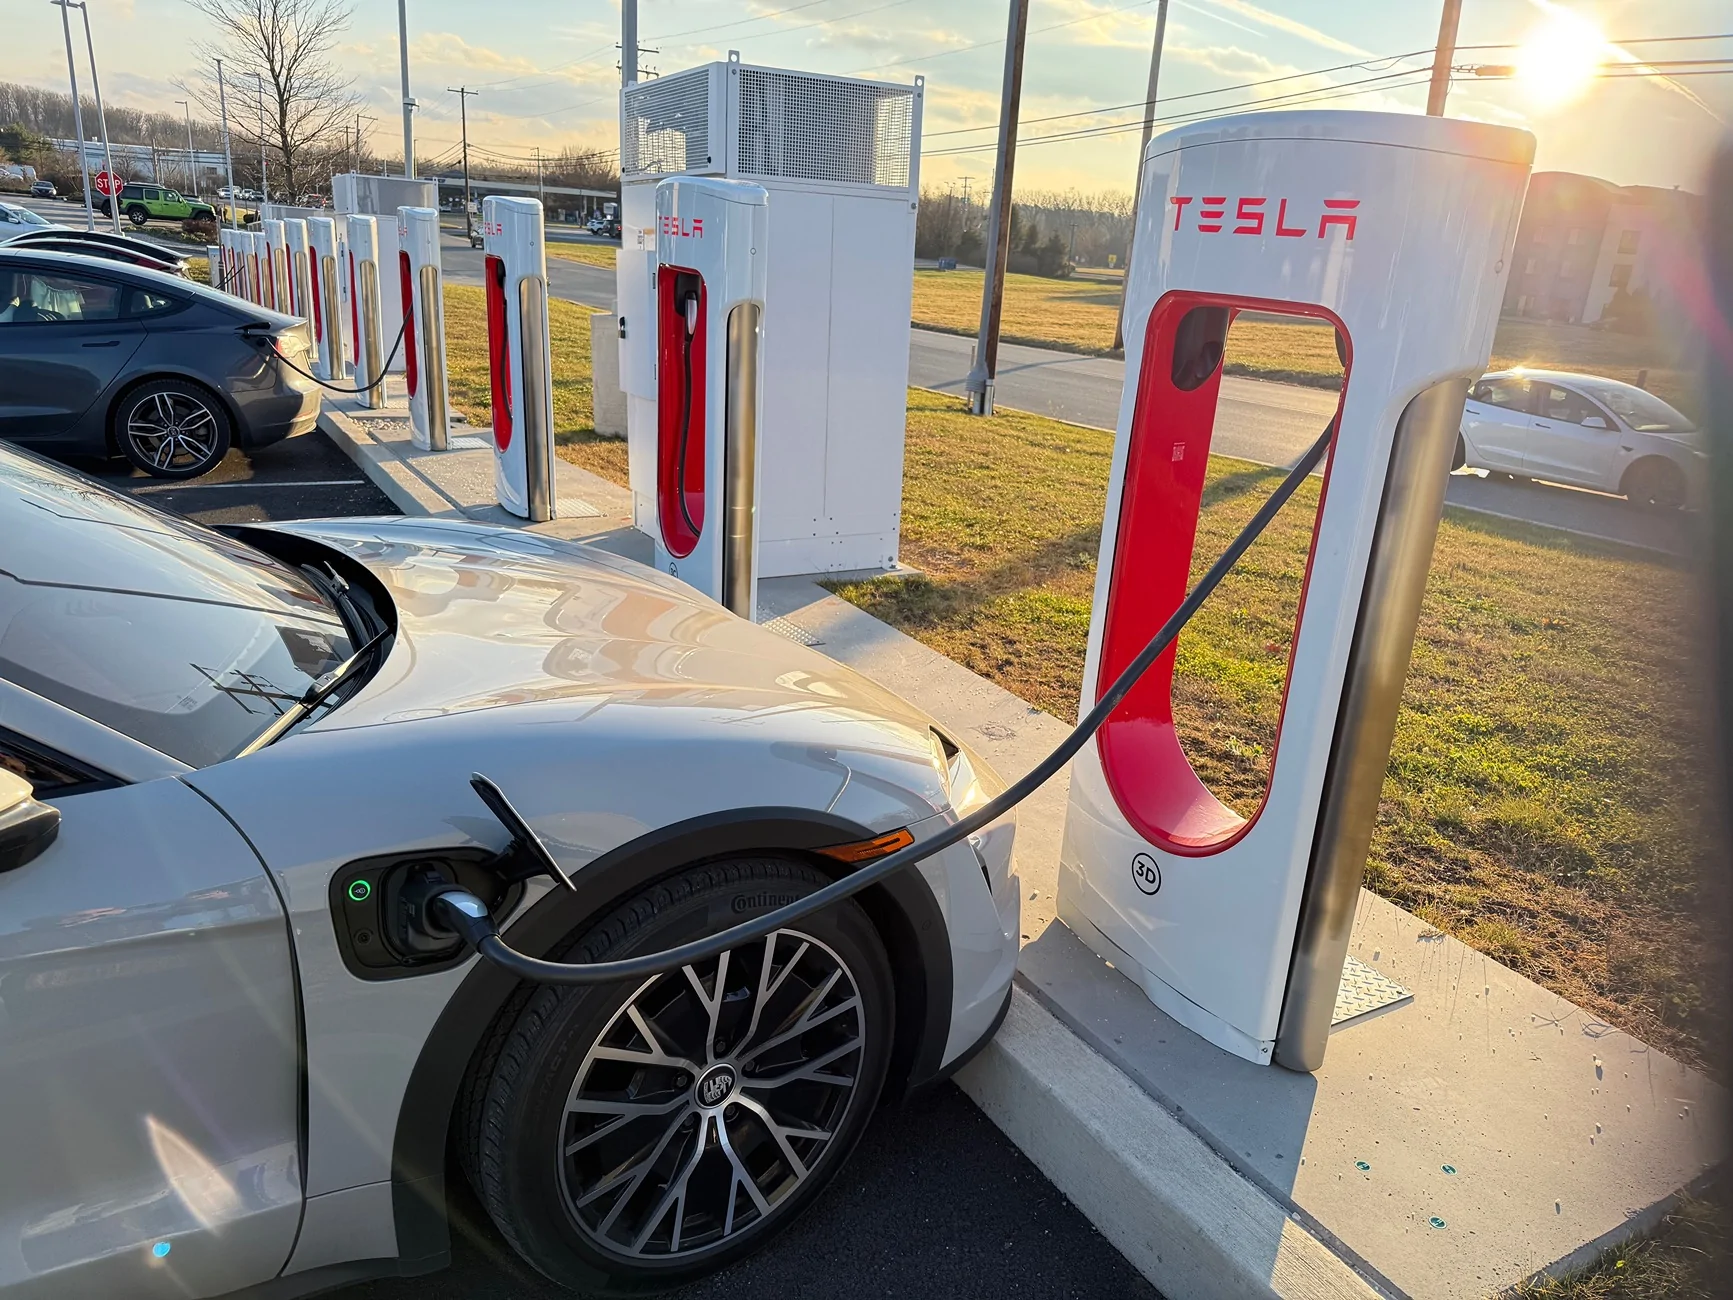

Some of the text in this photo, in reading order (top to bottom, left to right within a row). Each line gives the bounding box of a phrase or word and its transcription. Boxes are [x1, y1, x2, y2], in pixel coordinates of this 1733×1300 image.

[97, 179, 121, 189] STP
[1170, 196, 1361, 241] TESLA
[1135, 860, 1157, 885] 3D
